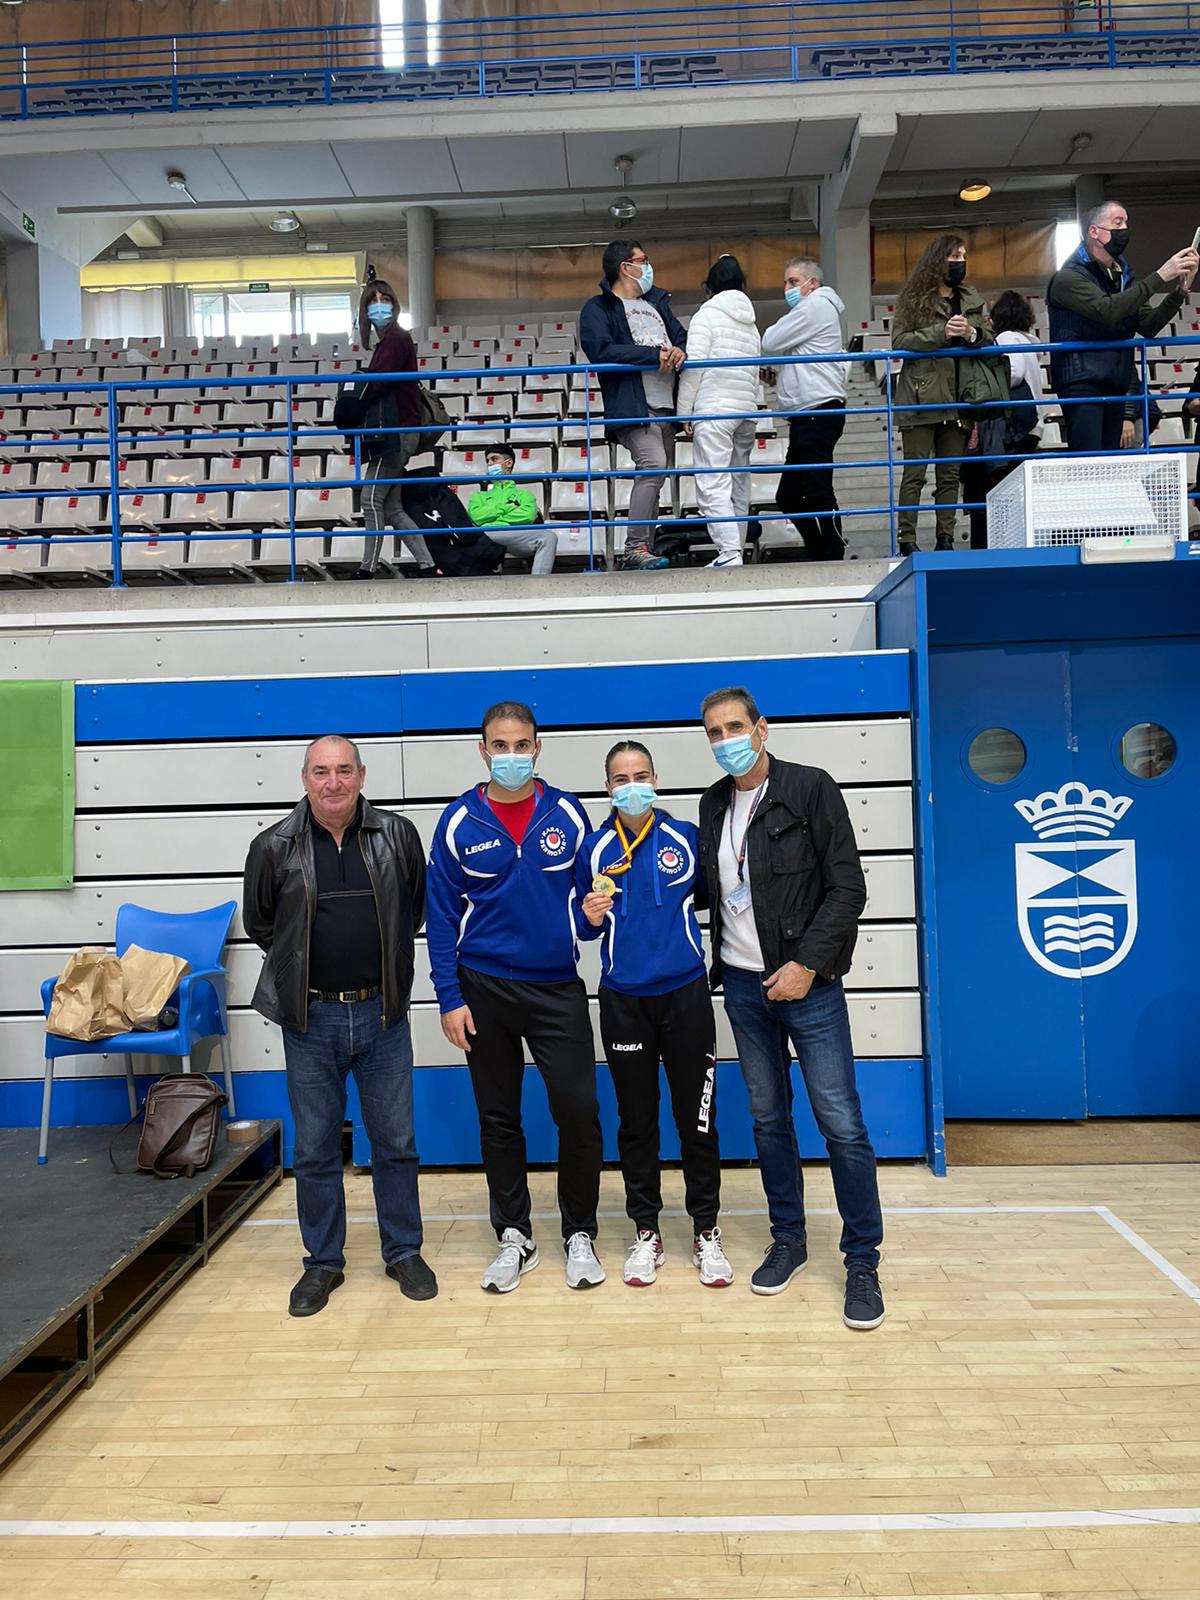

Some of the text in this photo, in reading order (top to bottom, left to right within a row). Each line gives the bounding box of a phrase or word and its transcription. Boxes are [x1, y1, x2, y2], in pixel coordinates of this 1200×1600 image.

[541, 826, 566, 839] KARATE
[464, 838, 501, 856] LEGEA
[657, 846, 682, 858] KARATE
[612, 1042, 643, 1052] LEGEA
[697, 1066, 715, 1134] LEGEA
